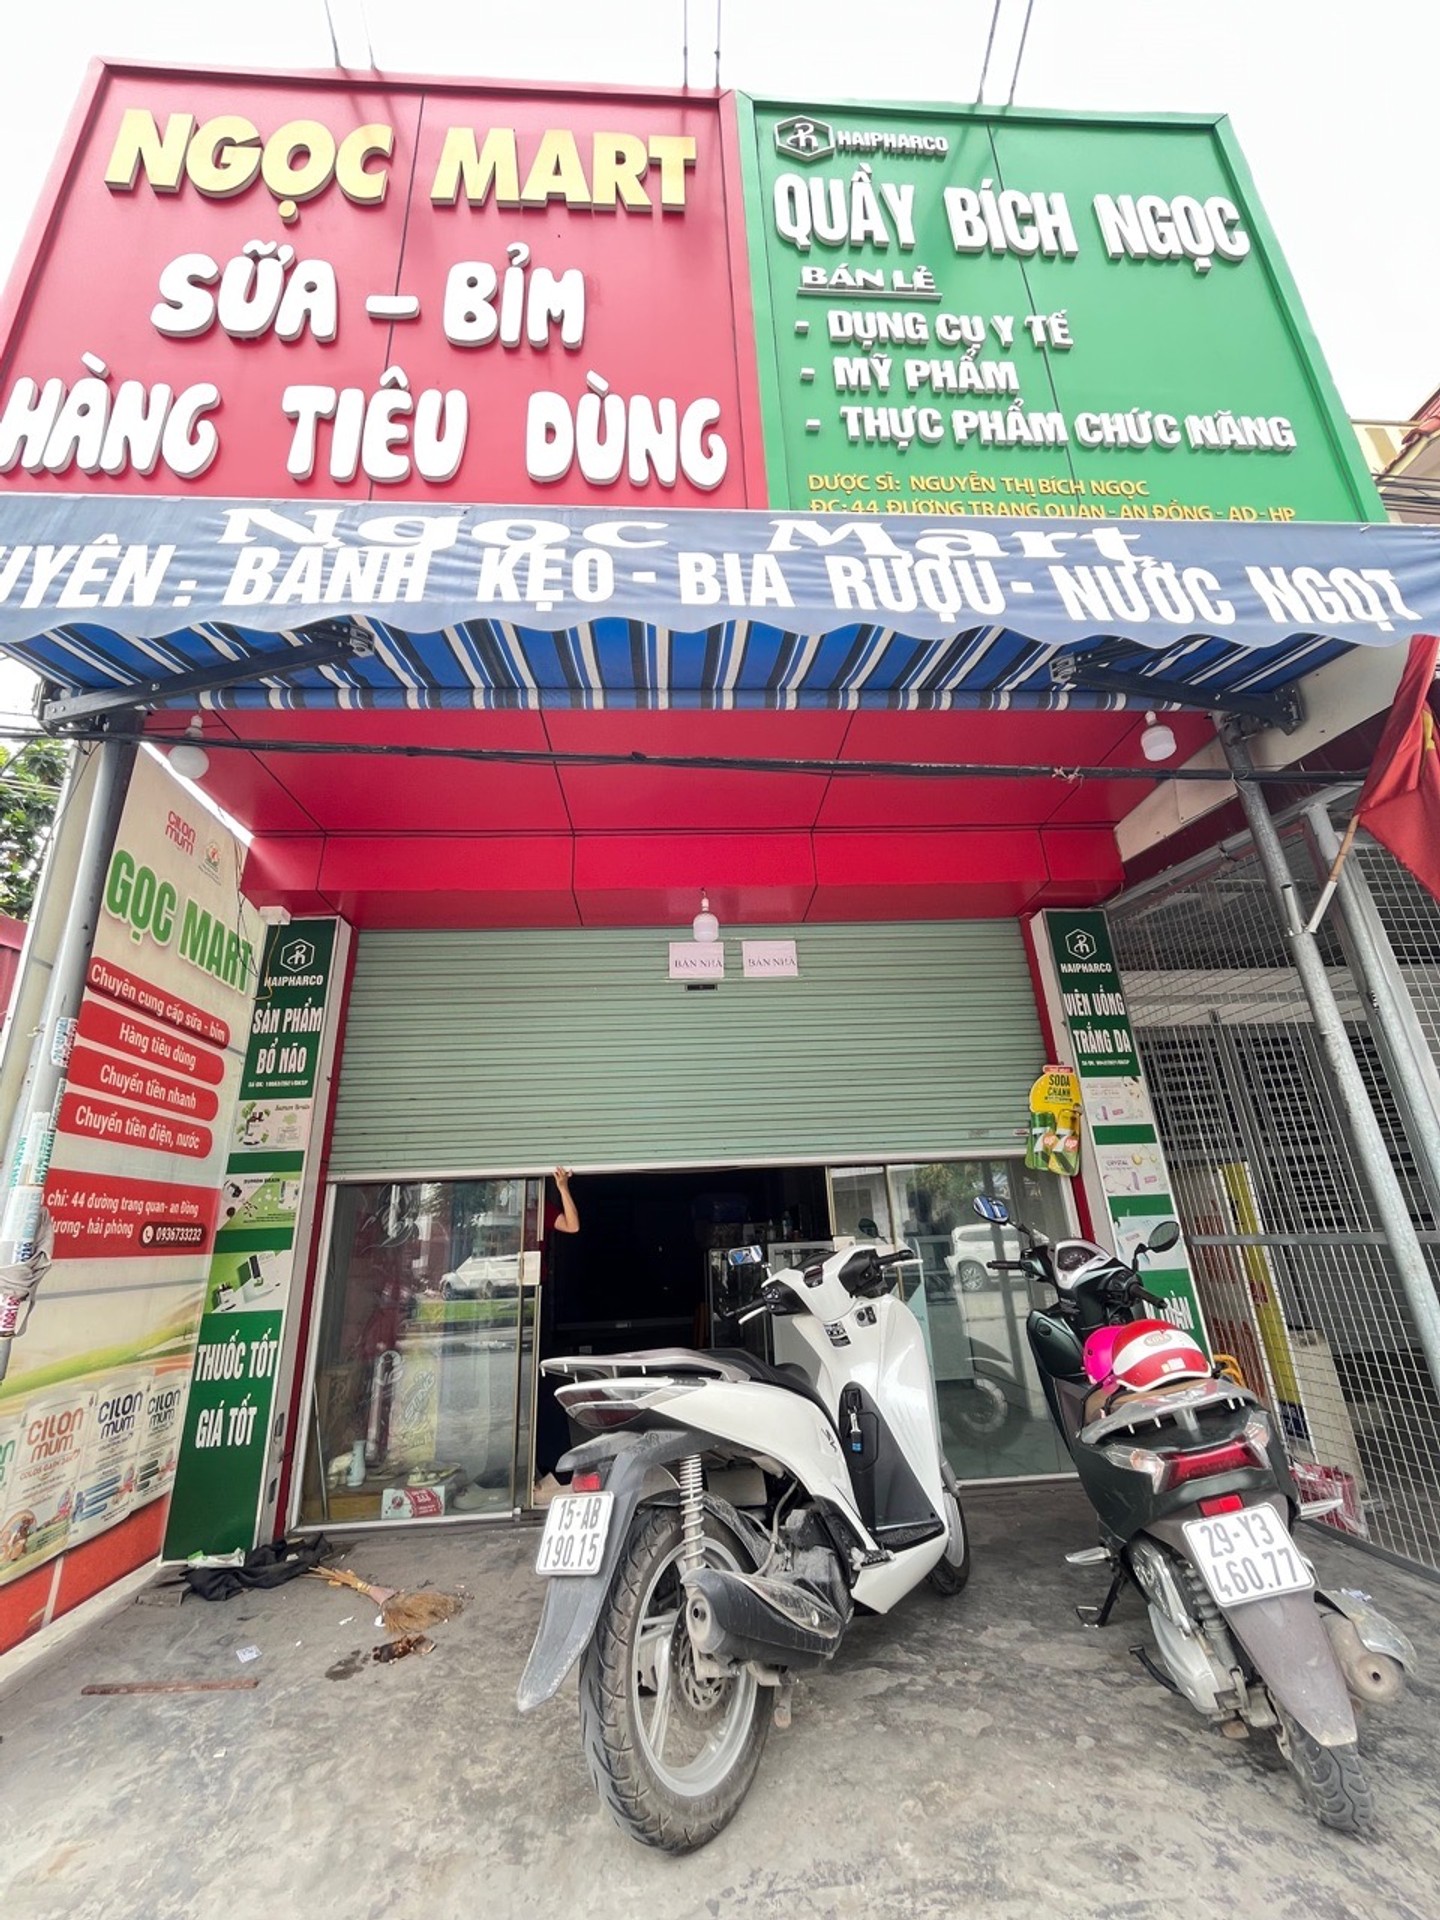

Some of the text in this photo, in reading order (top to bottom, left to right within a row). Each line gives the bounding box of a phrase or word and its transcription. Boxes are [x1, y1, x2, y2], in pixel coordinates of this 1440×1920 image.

[104, 108, 696, 224] NGỌC MART
[837, 131, 949, 156] HAIPHARCO
[774, 162, 1252, 274] QUẦY BÍCH NGỌC
[150, 239, 338, 343] SỮA
[443, 241, 586, 351] BỈM
[801, 263, 936, 291] BÁN LẺ
[826, 309, 929, 351] DỤNG
[935, 312, 986, 350] CỤ
[990, 315, 1014, 348] Y
[1024, 308, 1074, 350] TẾ
[832, 353, 893, 392] MỸ
[904, 346, 1020, 396] PHẨM
[0, 351, 728, 494] HÀNG TIÊU DÙNG
[839, 404, 944, 451] THỰC
[951, 398, 1069, 447] PHẨM
[1073, 406, 1181, 450] CHỨC
[1184, 409, 1297, 455] NĂNG
[808, 474, 870, 495] DƯỢC
[909, 470, 996, 493] NGUYỄN
[1001, 476, 1036, 498] THỊ
[1039, 475, 1087, 496] BÍCH
[1091, 479, 1150, 500] NGỌC
[968, 500, 1041, 517] TRANG
[217, 508, 1153, 561] Ngọc Mart
[475, 547, 615, 612] KẸO
[678, 551, 796, 608] BIA
[824, 552, 1006, 623] RƯỢU
[1048, 558, 1235, 625] NƯỚC
[1245, 566, 1423, 631] NGỌT
[180, 898, 254, 995] MART
[1060, 962, 1113, 974] HAIPHARCO
[91, 964, 136, 999] Chuyên
[138, 991, 165, 1017] cung
[166, 1003, 185, 1025] cấp
[185, 1013, 202, 1032] sữa
[264, 974, 324, 988] HAIPHARCO
[1062, 984, 1126, 1016] VIÊN UỐNG
[252, 997, 324, 1034] SẢN PHẨM
[1073, 1022, 1132, 1053] TRẮNG DA
[119, 1022, 196, 1071] Hàng tiêu dùng
[255, 1037, 307, 1074] BỔ NÃO
[100, 1064, 197, 1110] Chuyển tiền nhanh
[1049, 1074, 1071, 1088] SODA
[75, 1105, 123, 1135] Chuyển
[125, 1116, 147, 1139] tiền
[176, 1131, 201, 1150] nước
[71, 1192, 86, 1208] 44
[87, 1192, 119, 1214] đường
[120, 1197, 143, 1215] trang
[103, 1219, 135, 1239] phòng
[195, 1327, 278, 1381] THUỐC TỐT
[195, 1400, 225, 1449] GIÁ
[226, 1392, 258, 1447] TỐT
[558, 1497, 603, 1531] 15-AB
[1200, 1513, 1275, 1558] 29-Y3
[543, 1533, 600, 1568] 190.15
[1212, 1547, 1297, 1598] 460.77
